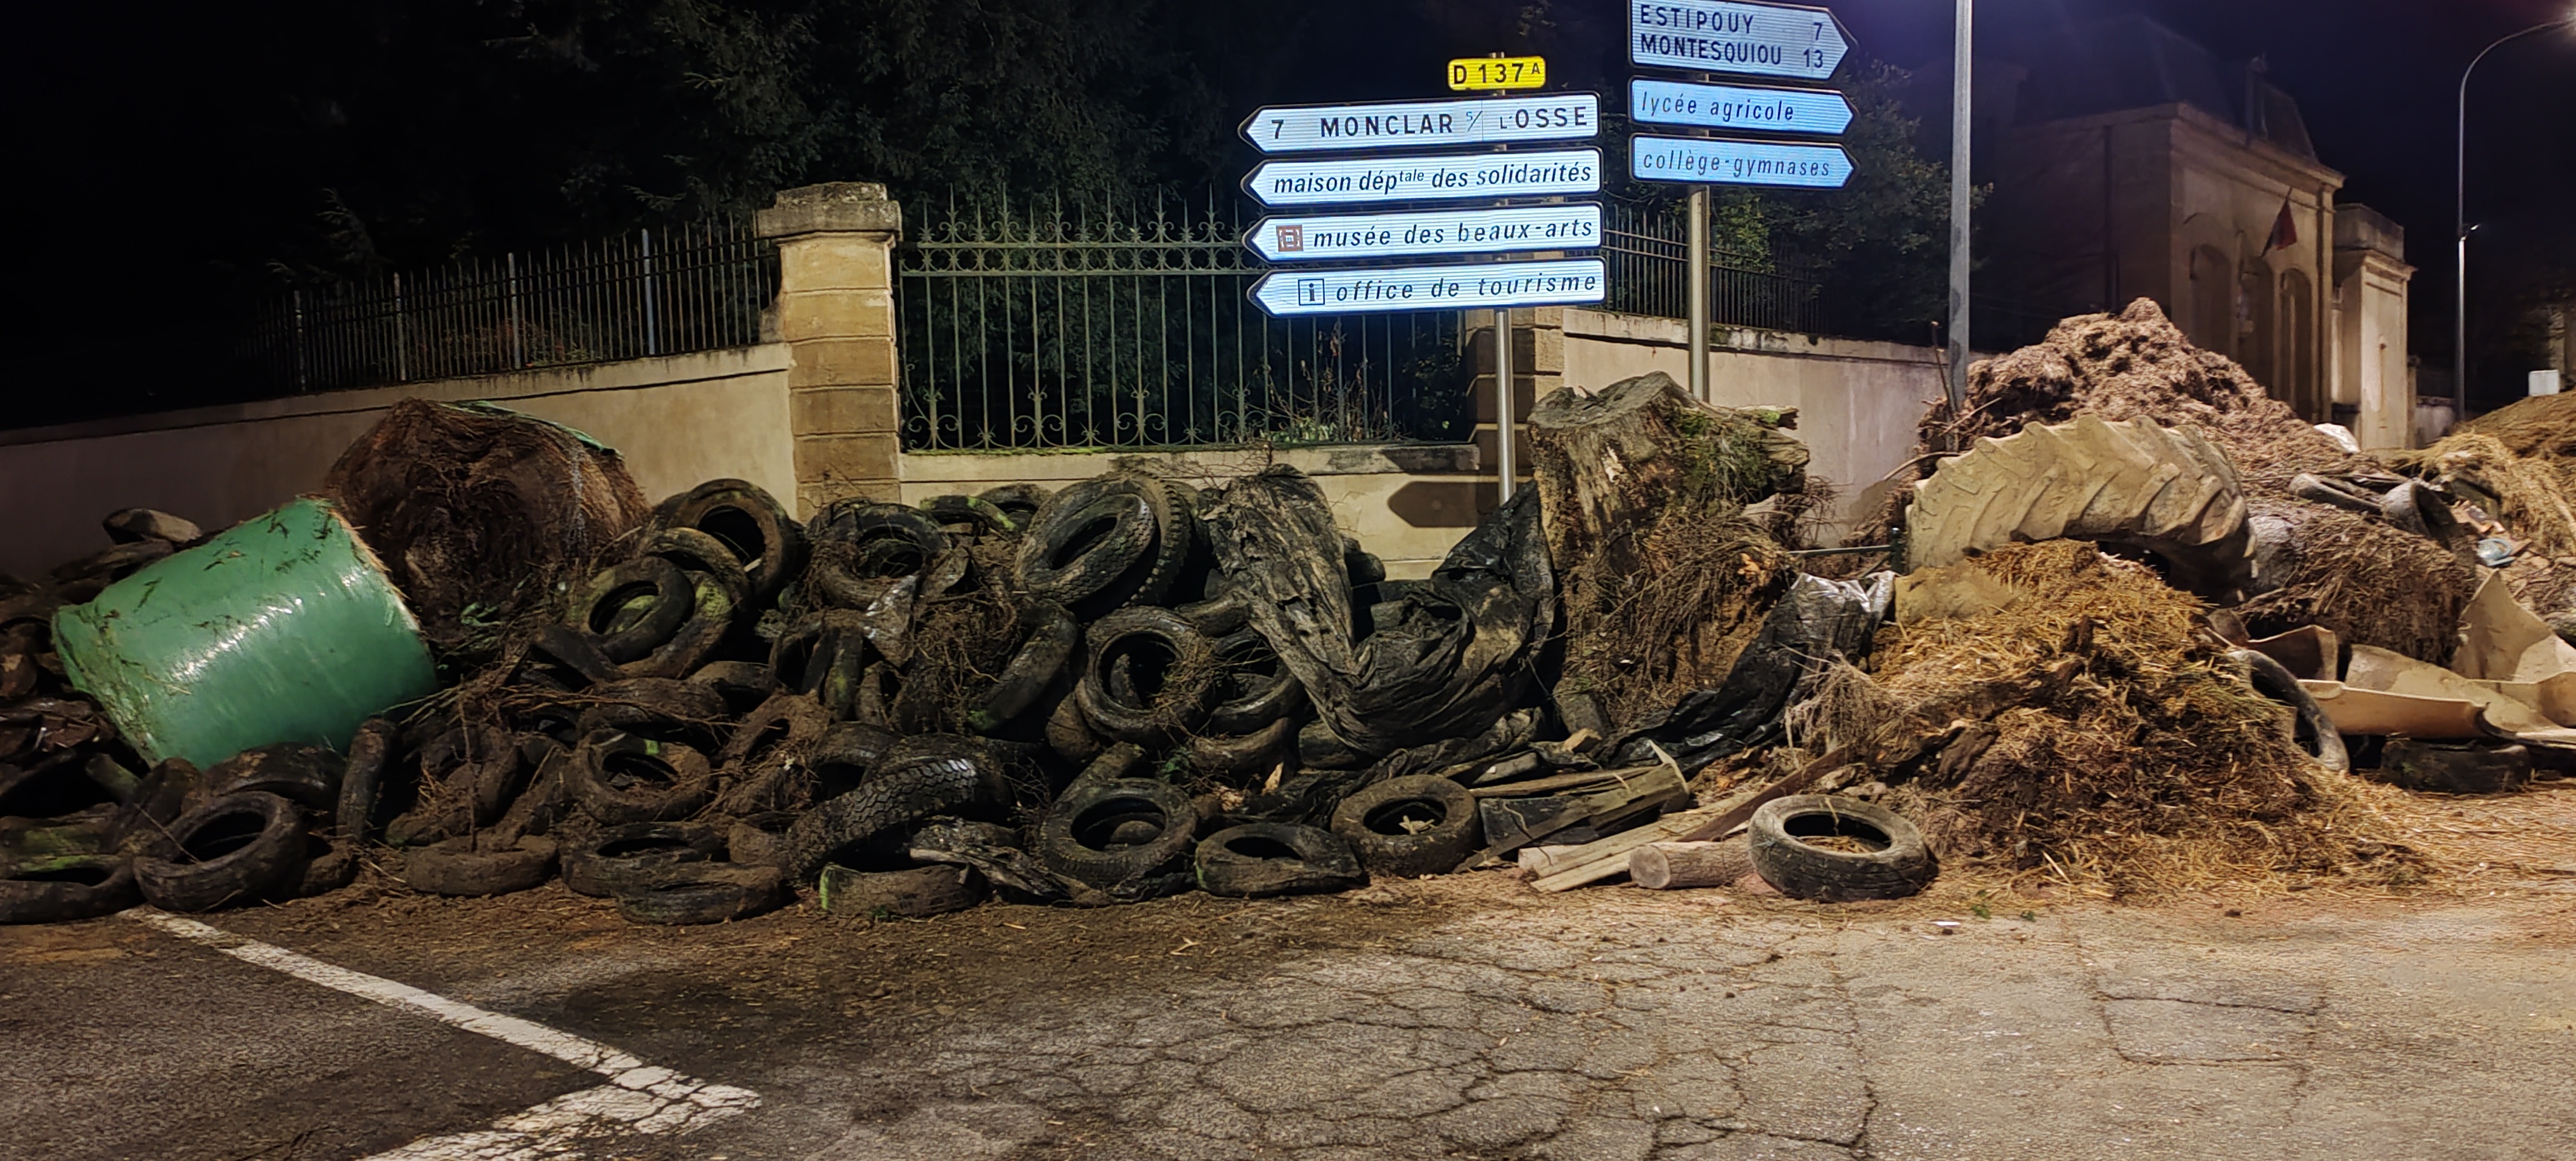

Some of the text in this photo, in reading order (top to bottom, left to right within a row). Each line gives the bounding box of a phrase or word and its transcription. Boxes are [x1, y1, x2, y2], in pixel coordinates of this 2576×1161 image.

[1640, 5, 1823, 41] ESTIPOUY 7
[1640, 34, 1824, 68] MONTESQUIOU 13
[1453, 65, 1467, 84] D
[1642, 91, 1794, 122] lycée agricole
[1271, 119, 1284, 139] 7
[1320, 113, 1453, 138] MONCLAR
[1644, 149, 1829, 177] collège-gymnases
[1274, 172, 1351, 193] maison
[1432, 168, 1468, 188] des
[1476, 162, 1591, 185] solidarités
[1314, 219, 1592, 247] musée des beaux-arts
[1336, 279, 1413, 301] office
[1431, 278, 1459, 297] de
[1478, 273, 1595, 295] tourisme
